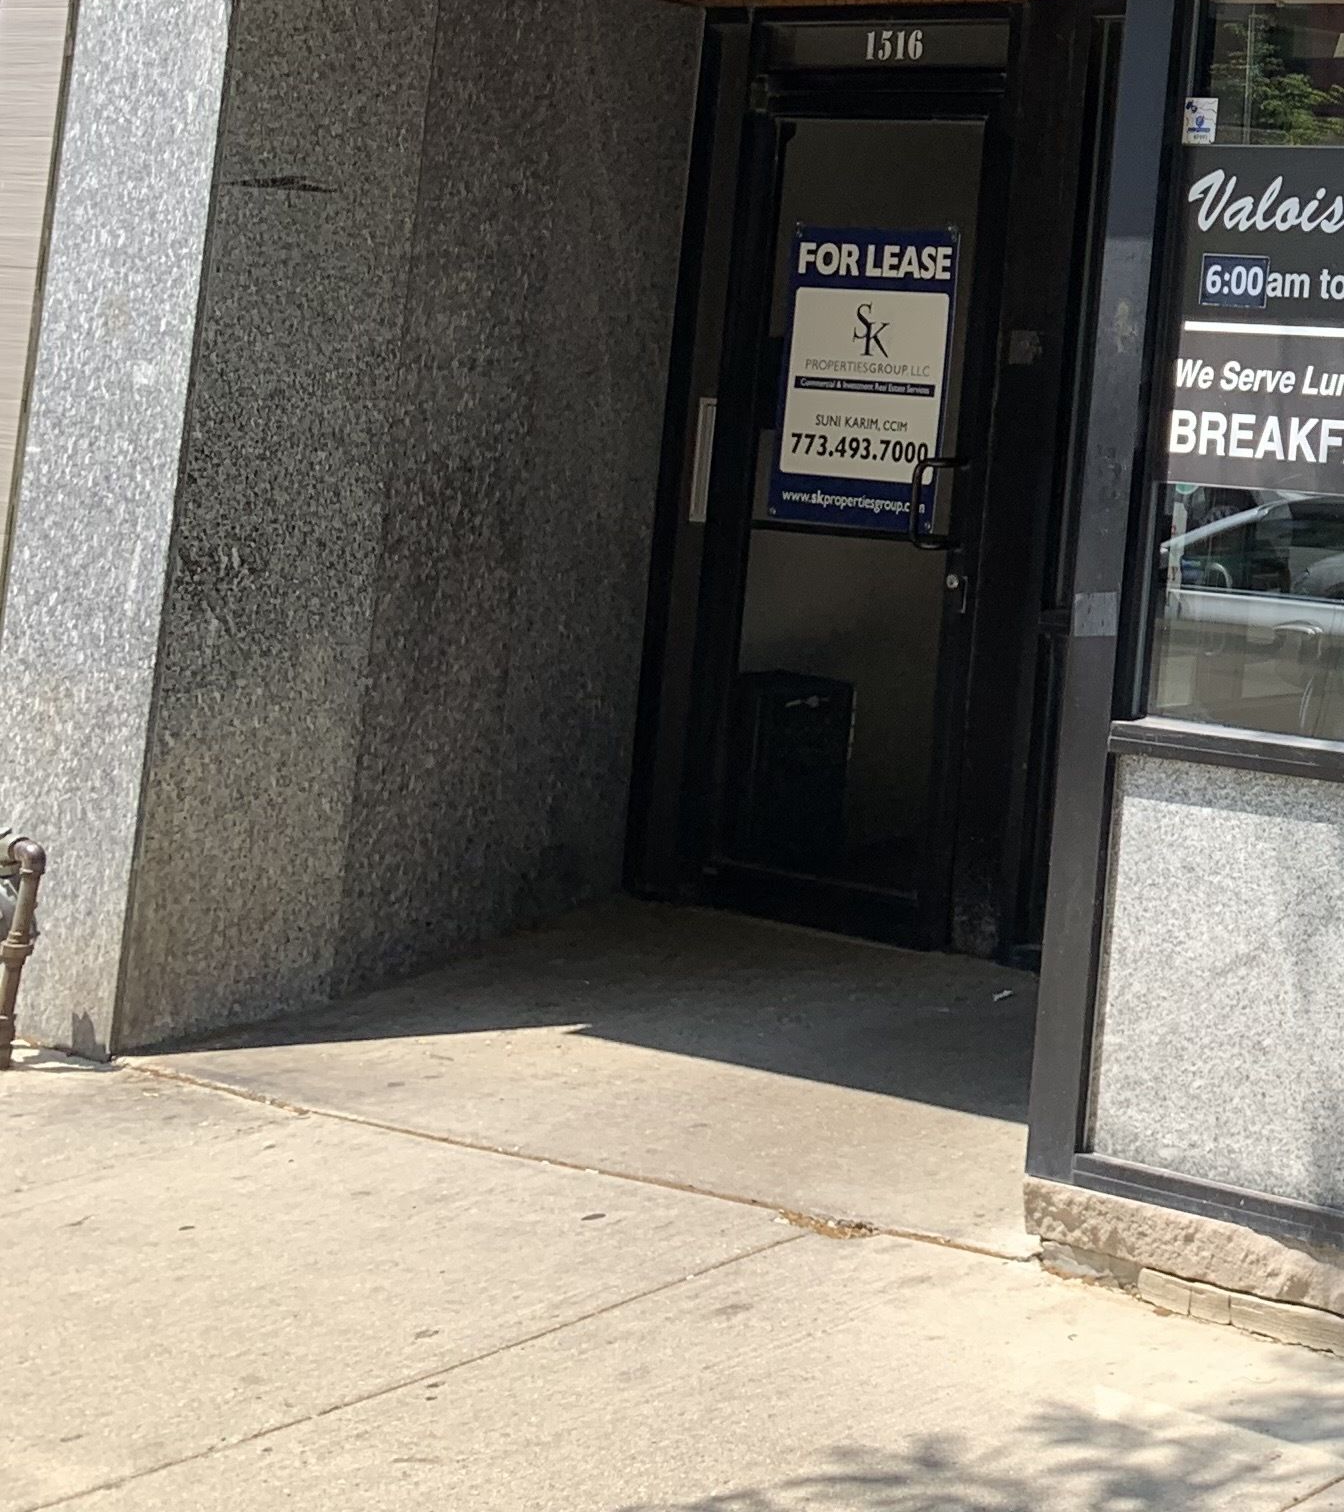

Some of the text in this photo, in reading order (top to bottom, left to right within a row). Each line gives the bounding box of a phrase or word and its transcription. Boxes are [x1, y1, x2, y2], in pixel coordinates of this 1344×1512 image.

[865, 28, 924, 61] 1516
[797, 241, 952, 281] FOR LEASE
[1174, 357, 1214, 390] We
[1220, 360, 1296, 395] Serve
[815, 413, 842, 428] SUNI
[790, 432, 929, 464] 773.493.7000
[782, 489, 926, 516] www.skpropertiesgroup.cm
